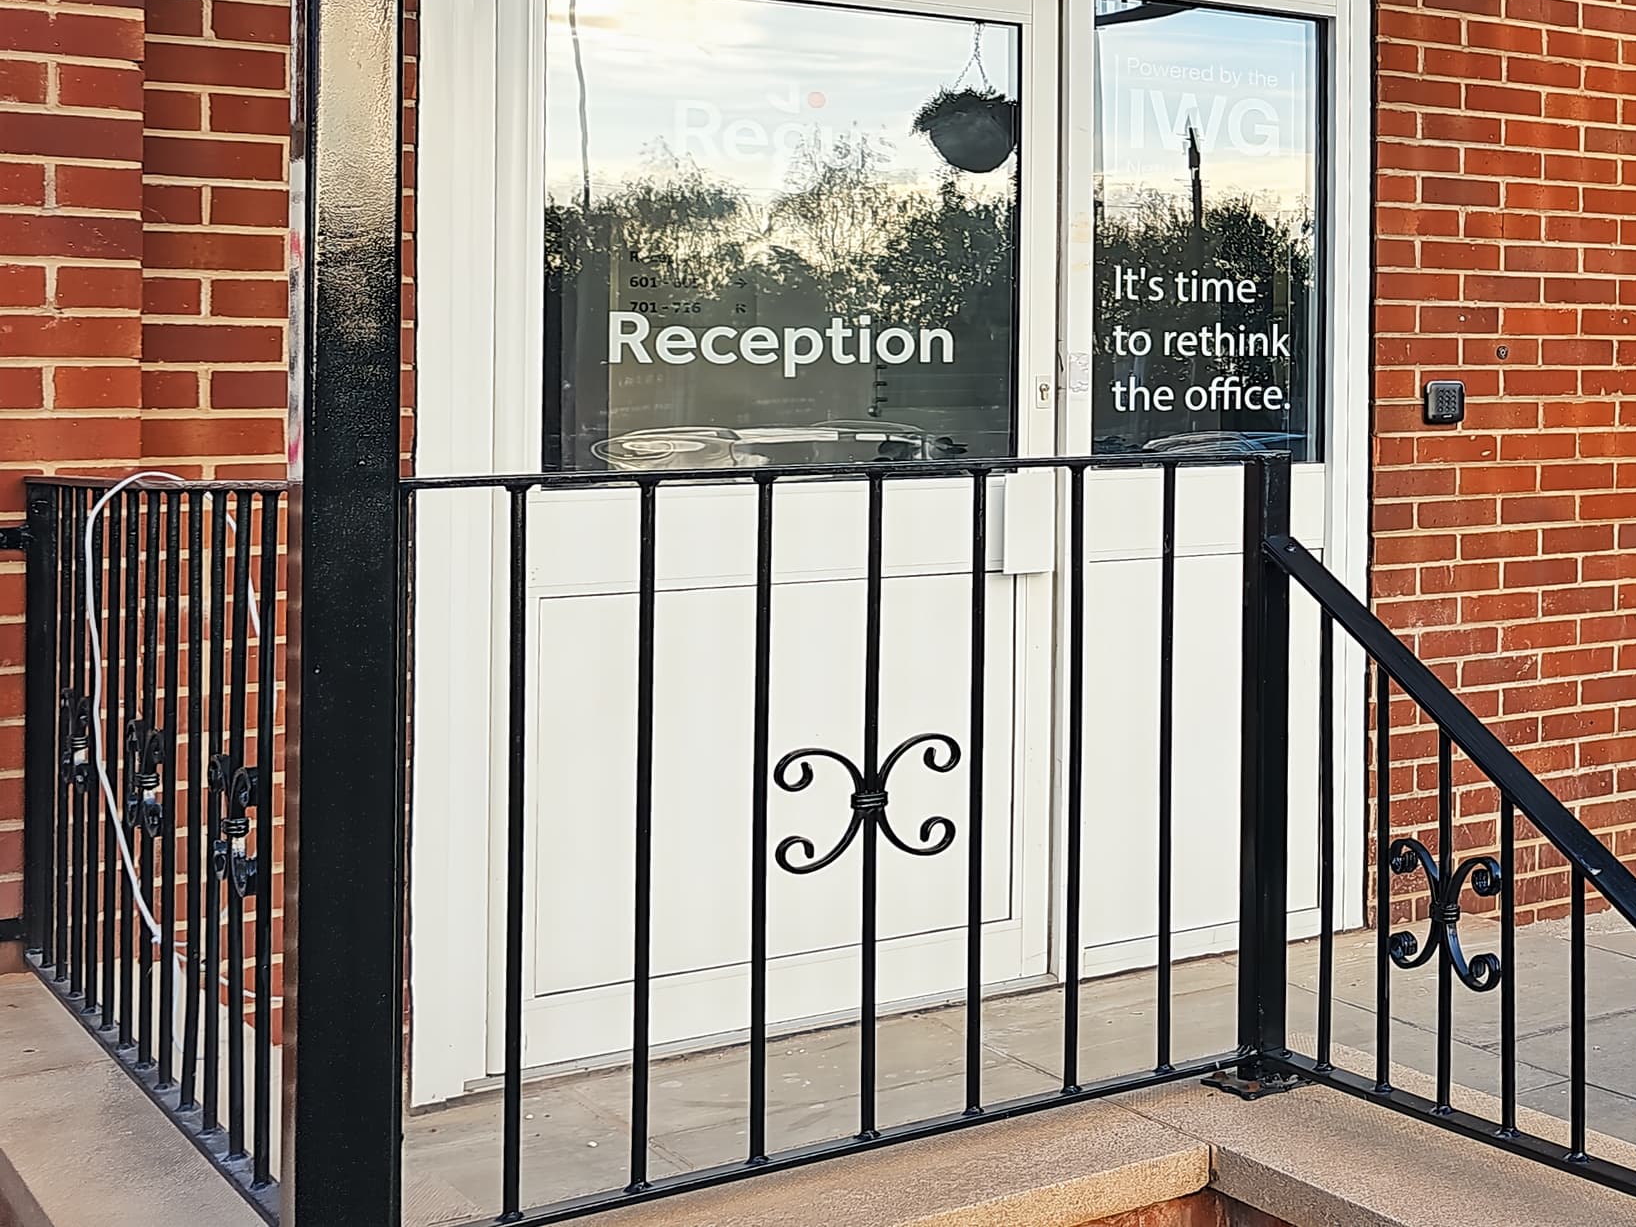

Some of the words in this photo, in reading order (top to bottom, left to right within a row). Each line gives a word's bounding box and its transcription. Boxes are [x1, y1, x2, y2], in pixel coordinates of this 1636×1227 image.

[1127, 57, 1214, 81] Powered
[1220, 64, 1243, 89] by
[1248, 69, 1279, 88] the
[1129, 88, 1280, 156] IWG
[629, 276, 658, 289] 601
[1114, 265, 1164, 302] It's
[1175, 270, 1257, 303] time
[629, 301, 658, 314] 701
[608, 311, 955, 378] Reception
[1113, 325, 1152, 356] to
[1164, 323, 1291, 357] rethink
[1112, 376, 1174, 412] the
[1185, 376, 1291, 412] office.
